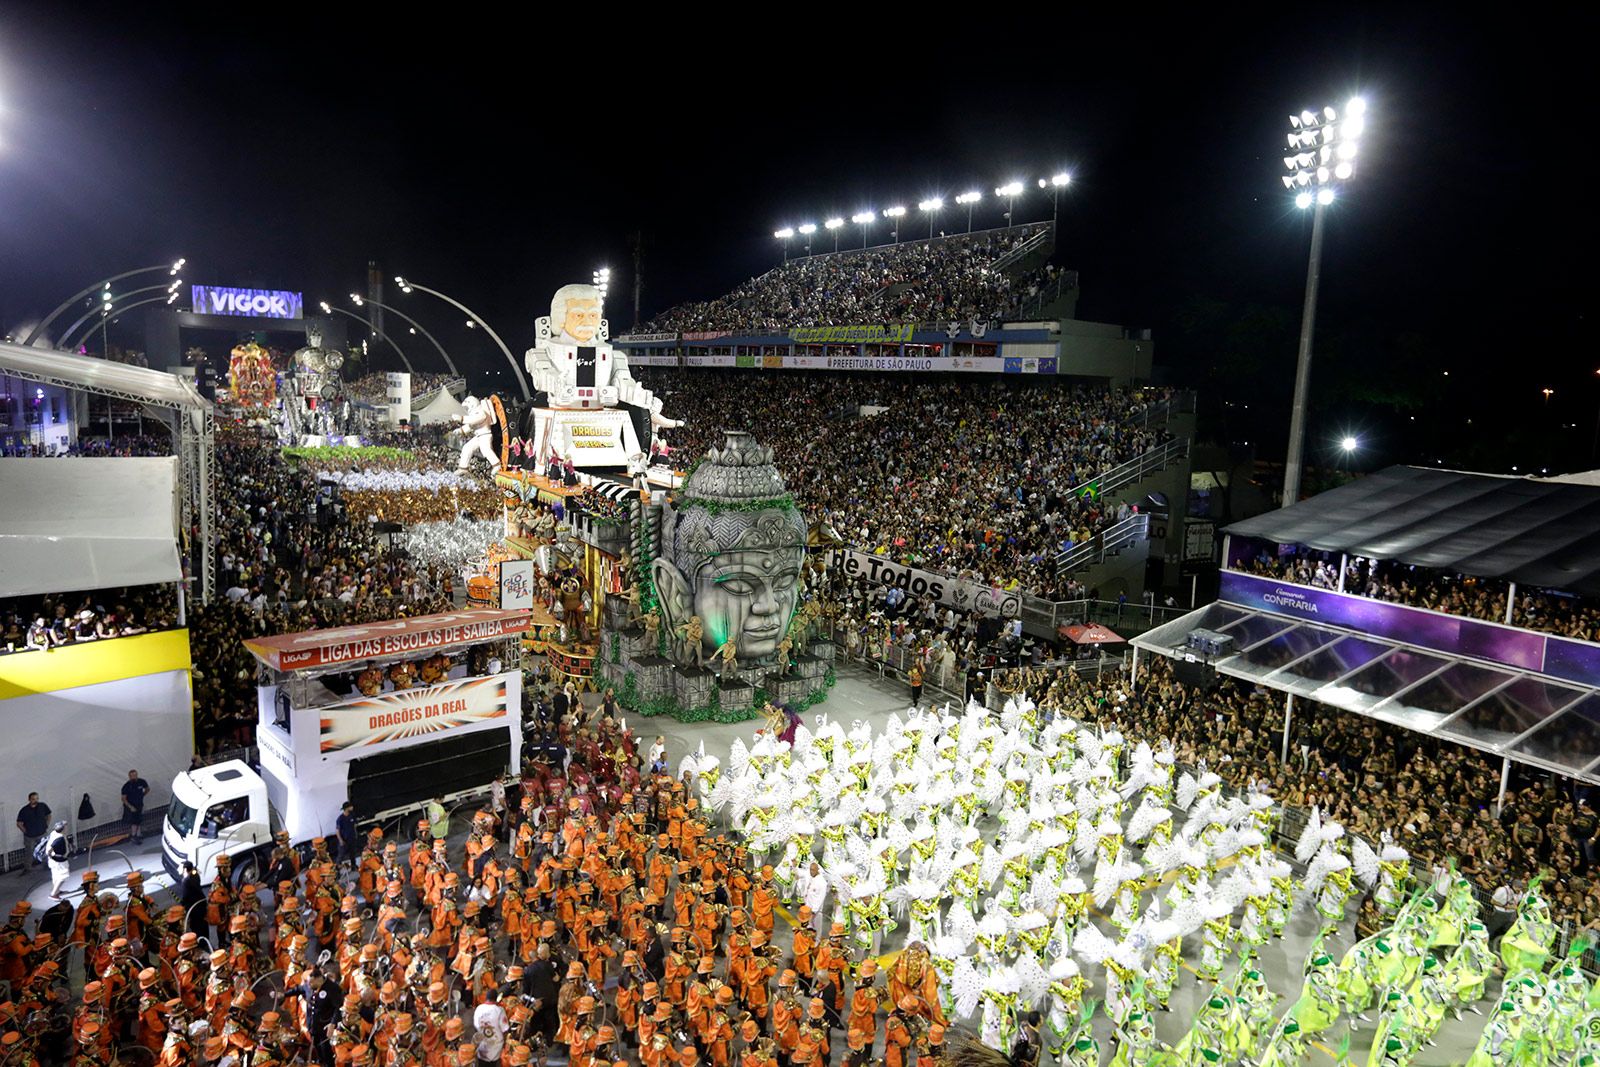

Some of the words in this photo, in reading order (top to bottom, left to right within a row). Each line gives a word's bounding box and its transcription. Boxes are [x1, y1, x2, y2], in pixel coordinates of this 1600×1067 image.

[210, 291, 287, 315] VIGOR
[832, 358, 874, 368] PREFEITURA
[876, 359, 885, 368] DE
[887, 357, 903, 369] SÃO
[905, 359, 932, 370] PAULO
[868, 556, 944, 600] Todos
[1263, 593, 1319, 613] CONFRARIA
[320, 643, 352, 663] LIGA
[354, 638, 381, 658] DAS
[384, 629, 442, 653] ESCOLAS
[444, 627, 461, 643] DE
[463, 620, 503, 640] SAMBA
[369, 706, 422, 729] DRAGÕES
[425, 704, 440, 718] DA
[442, 699, 467, 715] REAL
